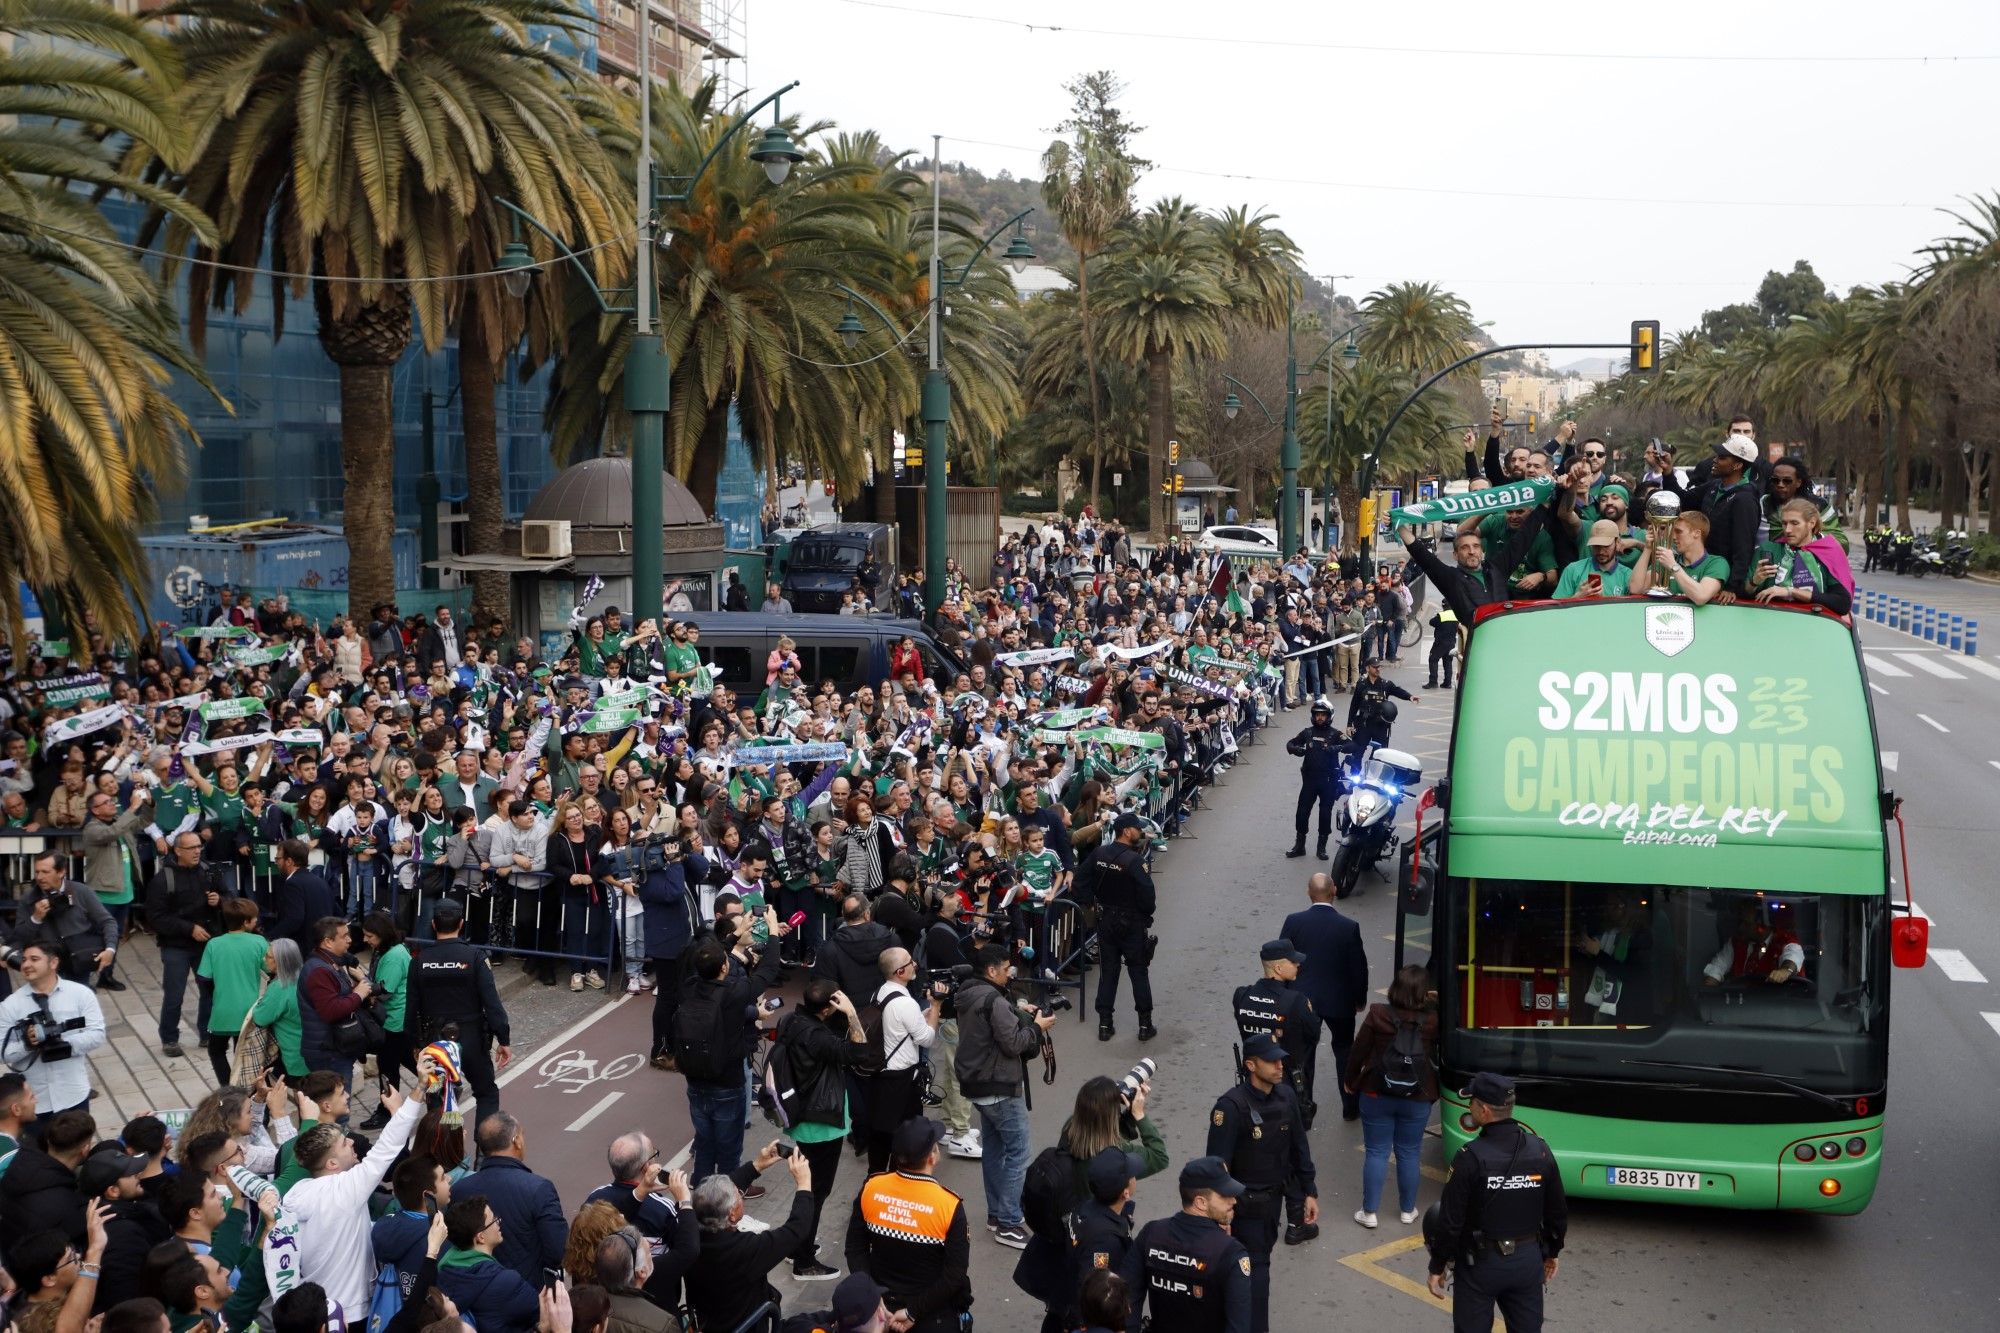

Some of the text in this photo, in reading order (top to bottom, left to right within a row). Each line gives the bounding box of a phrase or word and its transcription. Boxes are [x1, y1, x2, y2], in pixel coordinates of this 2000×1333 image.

[1437, 486, 1535, 513] Unicaja
[681, 581, 706, 592] ARMANI
[1020, 653, 1049, 662] Unicaja
[1168, 667, 1228, 697] UNICAJA
[1748, 677, 1812, 702] 22
[1539, 671, 1738, 735] S2MOS
[1748, 704, 1809, 735] 23
[220, 737, 249, 746] Unicaja
[1104, 734, 1146, 746] BALONCESTO
[1111, 727, 1141, 738] UNICAJA
[1504, 737, 1846, 823] CAMPEONES
[1559, 802, 1788, 837] COPA DEL REY
[1623, 830, 1718, 848] BADALONA
[783, 870, 793, 881] 2
[1239, 1008, 1278, 1020] POLICIA
[1855, 1096, 1868, 1117] 6
[1618, 1170, 1696, 1188] 8835 DYY
[873, 1193, 934, 1215] PROTECCION
[887, 1205, 912, 1218] CIVIL
[879, 1212, 918, 1228] MALAGA
[1149, 1248, 1198, 1268] POLICIA
[1151, 1275, 1191, 1296] U.I.P.
